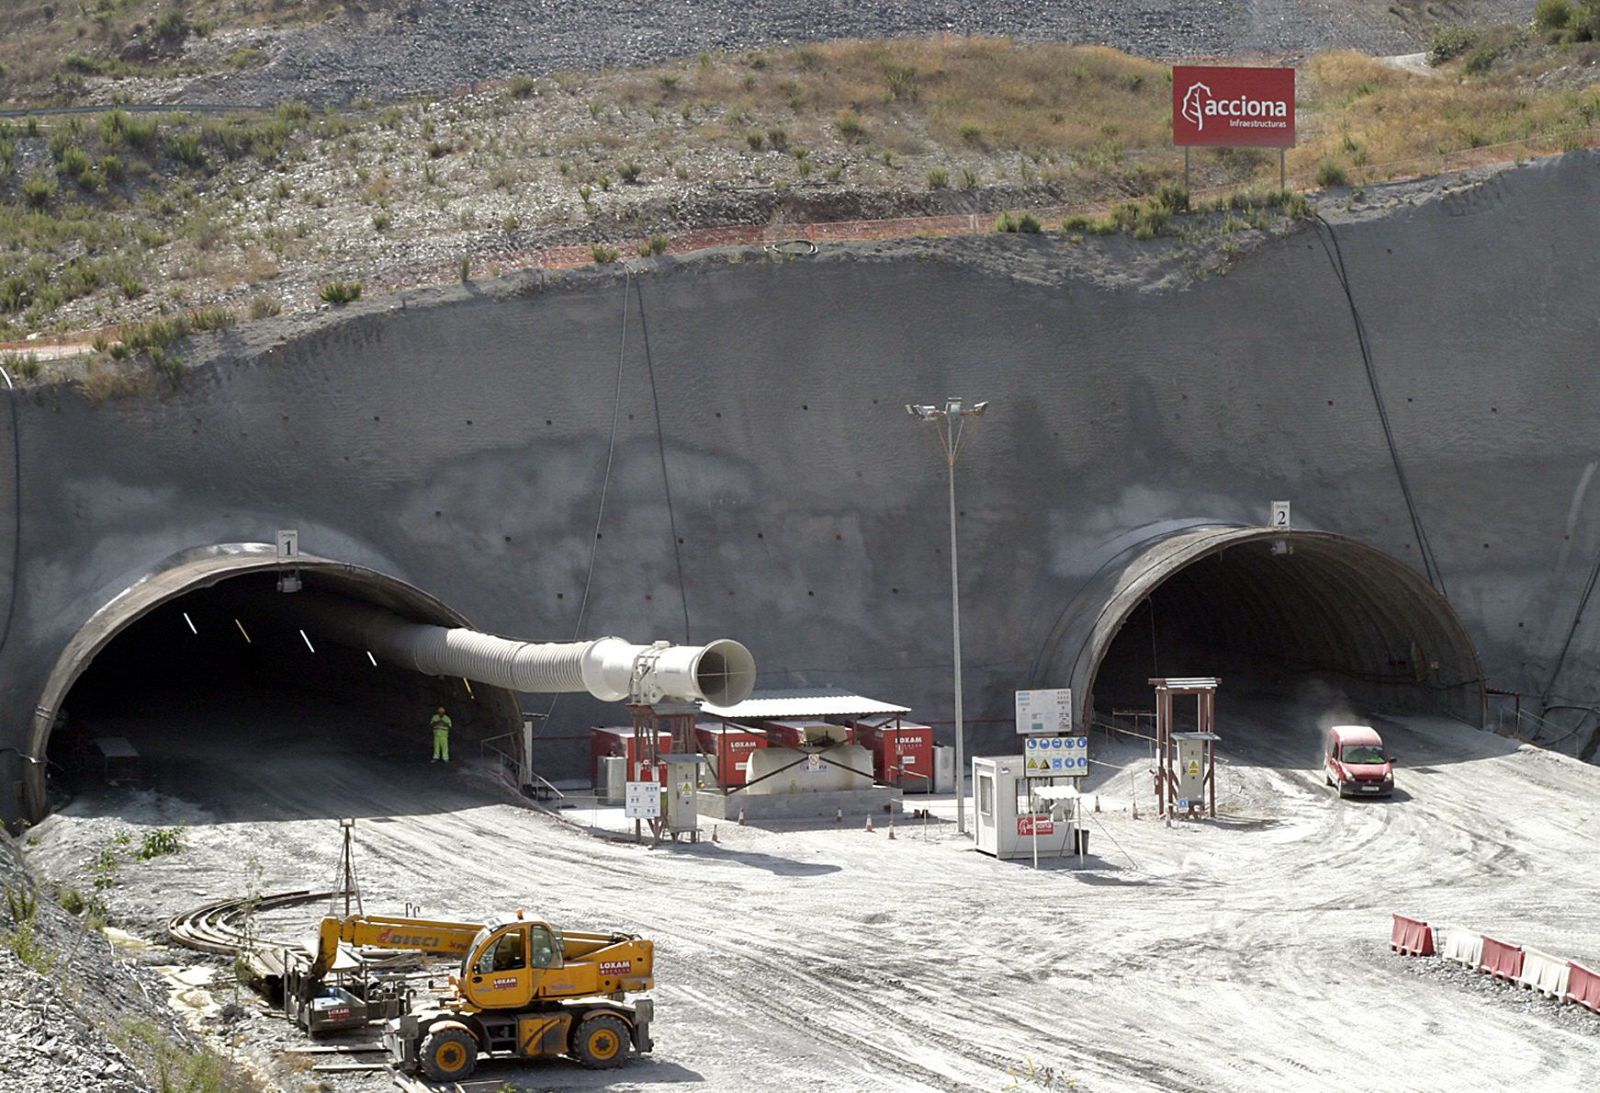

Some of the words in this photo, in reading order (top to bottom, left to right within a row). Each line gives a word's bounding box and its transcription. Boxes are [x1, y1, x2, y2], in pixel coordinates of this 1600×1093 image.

[1205, 95, 1287, 117] acciona
[1229, 119, 1287, 128] Infraestructuras
[1278, 511, 1286, 525] 2
[284, 540, 292, 555] 1
[600, 961, 630, 969] LOXAM
[493, 977, 517, 985] LOXAM
